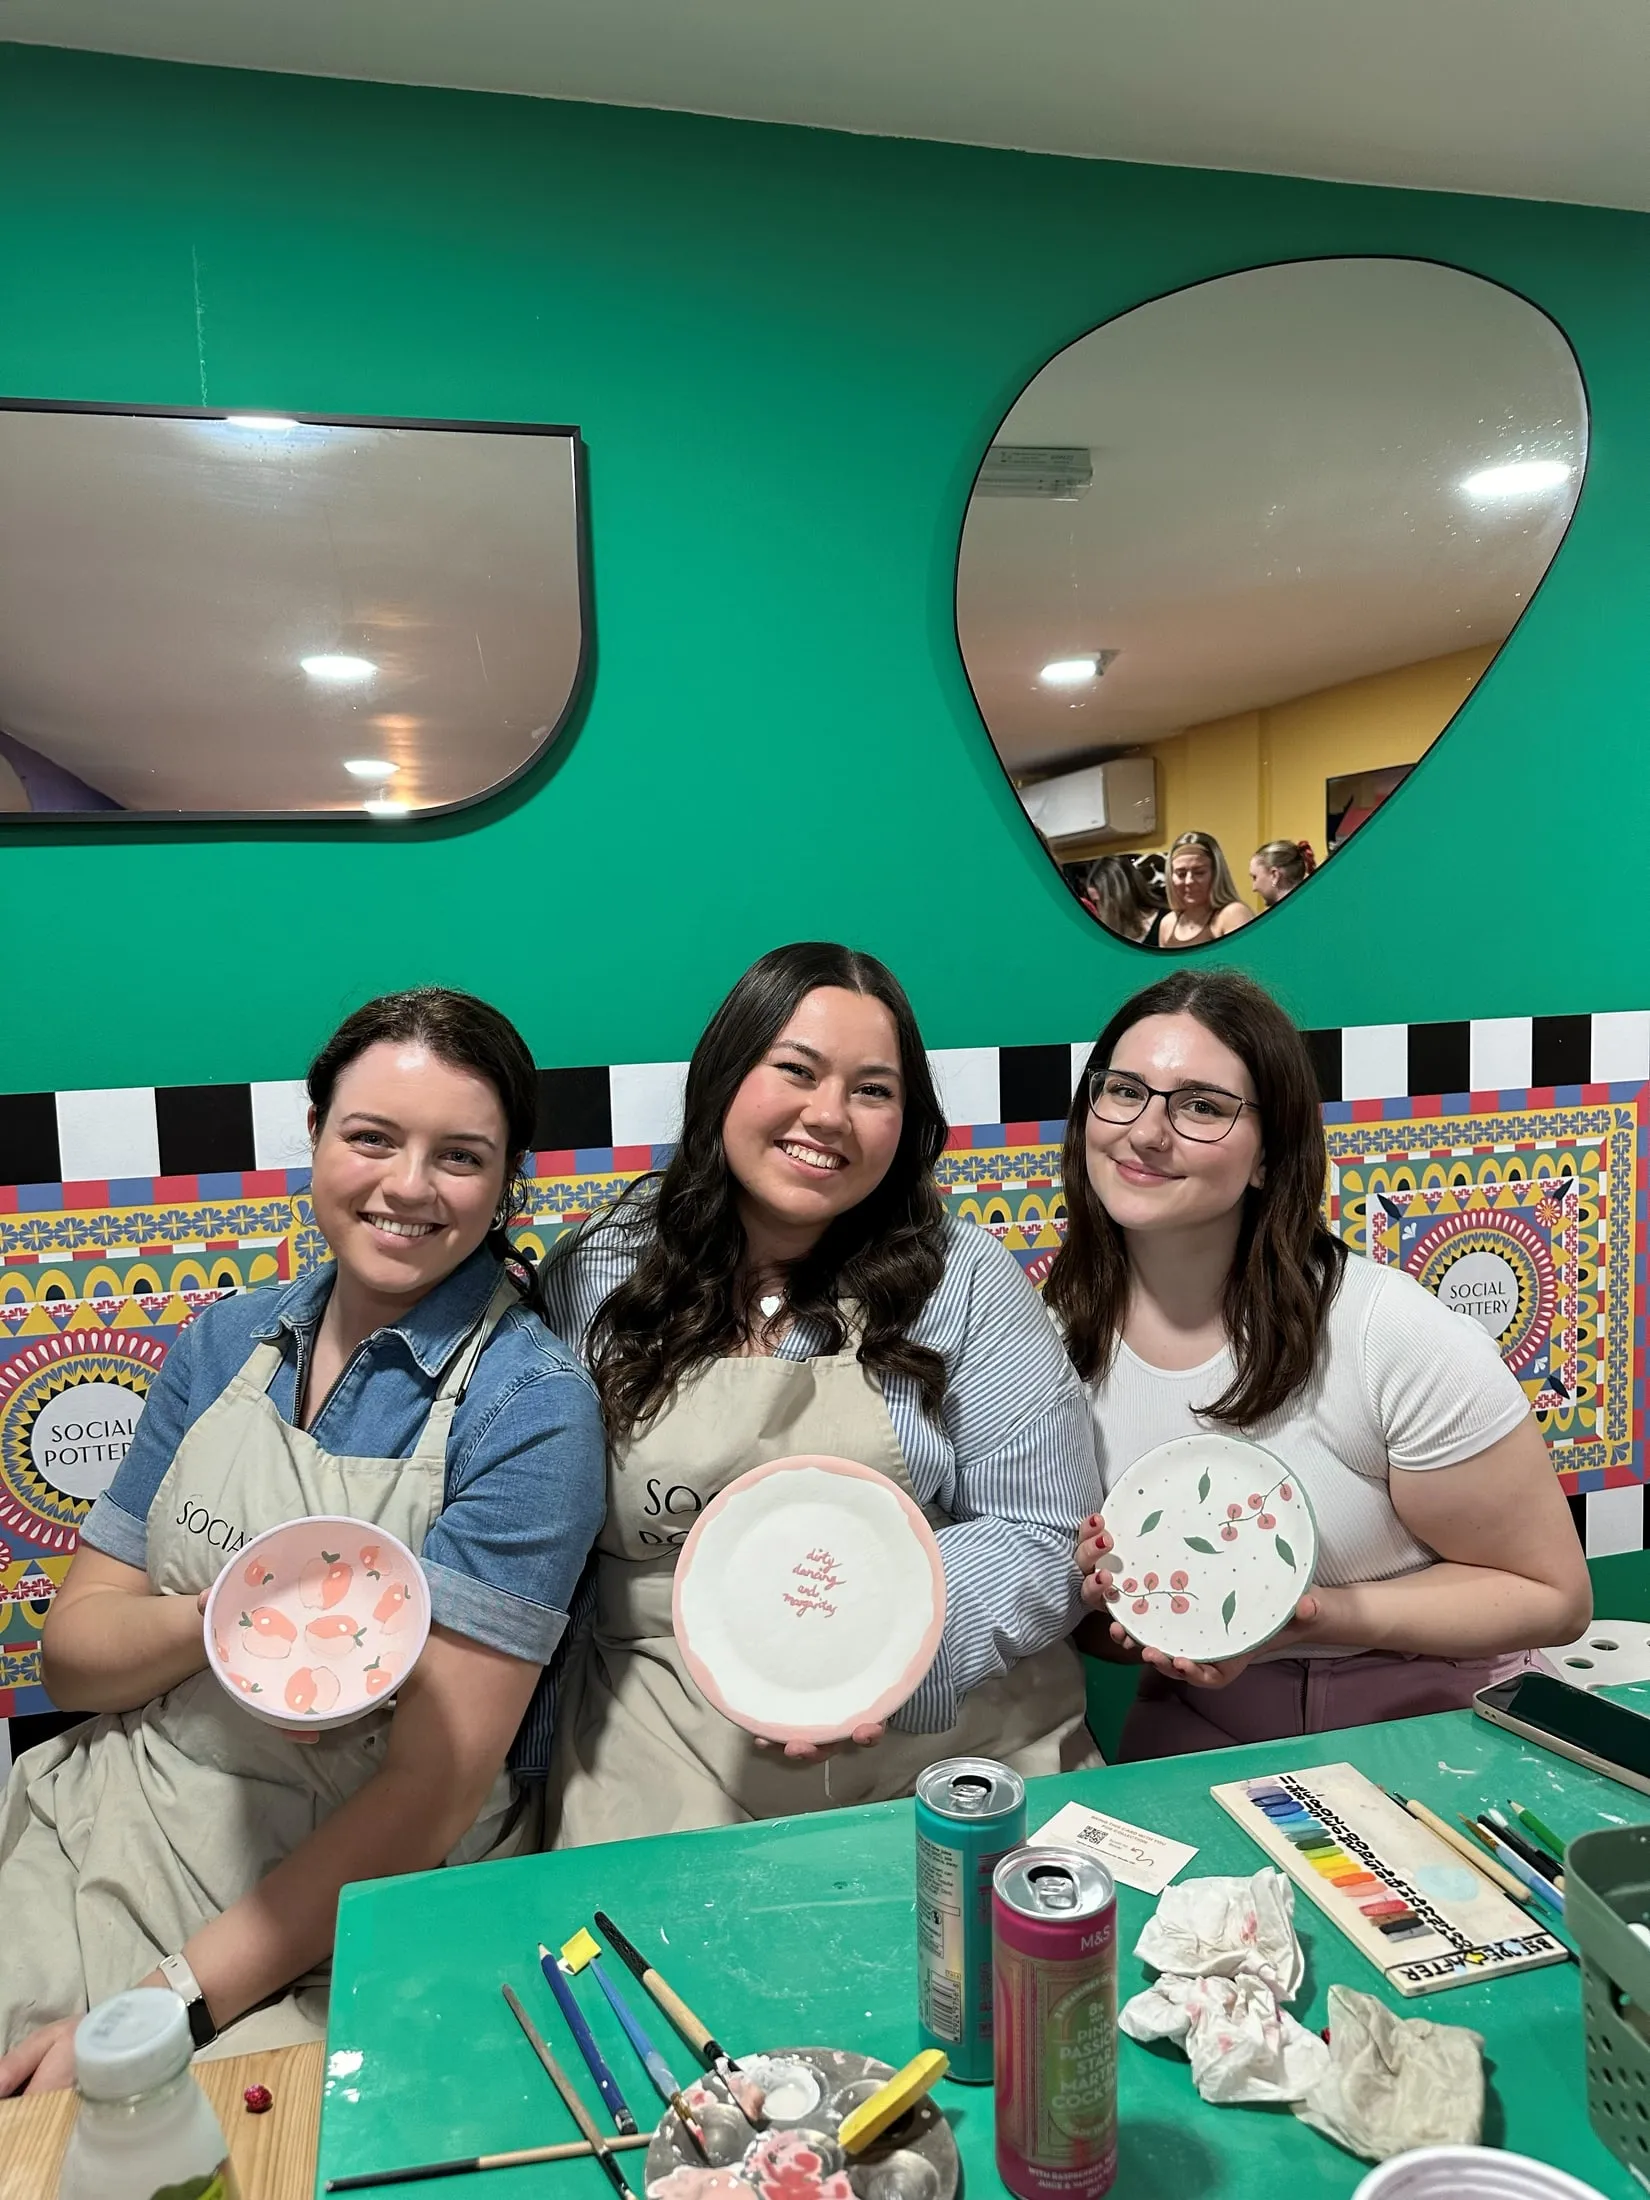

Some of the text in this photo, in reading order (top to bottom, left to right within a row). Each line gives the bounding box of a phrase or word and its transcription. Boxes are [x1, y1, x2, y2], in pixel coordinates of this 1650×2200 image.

[1450, 1281, 1506, 1299] SOCIAL
[51, 1418, 137, 1442] SOCIAL
[176, 1501, 253, 1552] SOCIA
[806, 1548, 843, 1574] dirty
[792, 1563, 847, 1591] dancing
[797, 1584, 820, 1598] and
[1278, 1775, 1297, 1784] 11
[1307, 1807, 1333, 1818] 05
[1319, 1815, 1345, 1827] 23
[1121, 1826, 1138, 1836] CARD
[1331, 1824, 1350, 1834] 10
[1336, 1832, 1362, 1845] 04
[1345, 1840, 1369, 1853] 03
[1363, 1859, 1385, 1870] 15
[1404, 1895, 1427, 1907] 92
[1080, 1924, 1111, 1951] M&S
[1077, 2020, 1113, 2043] PINK
[1077, 2047, 1111, 2075] STAR
